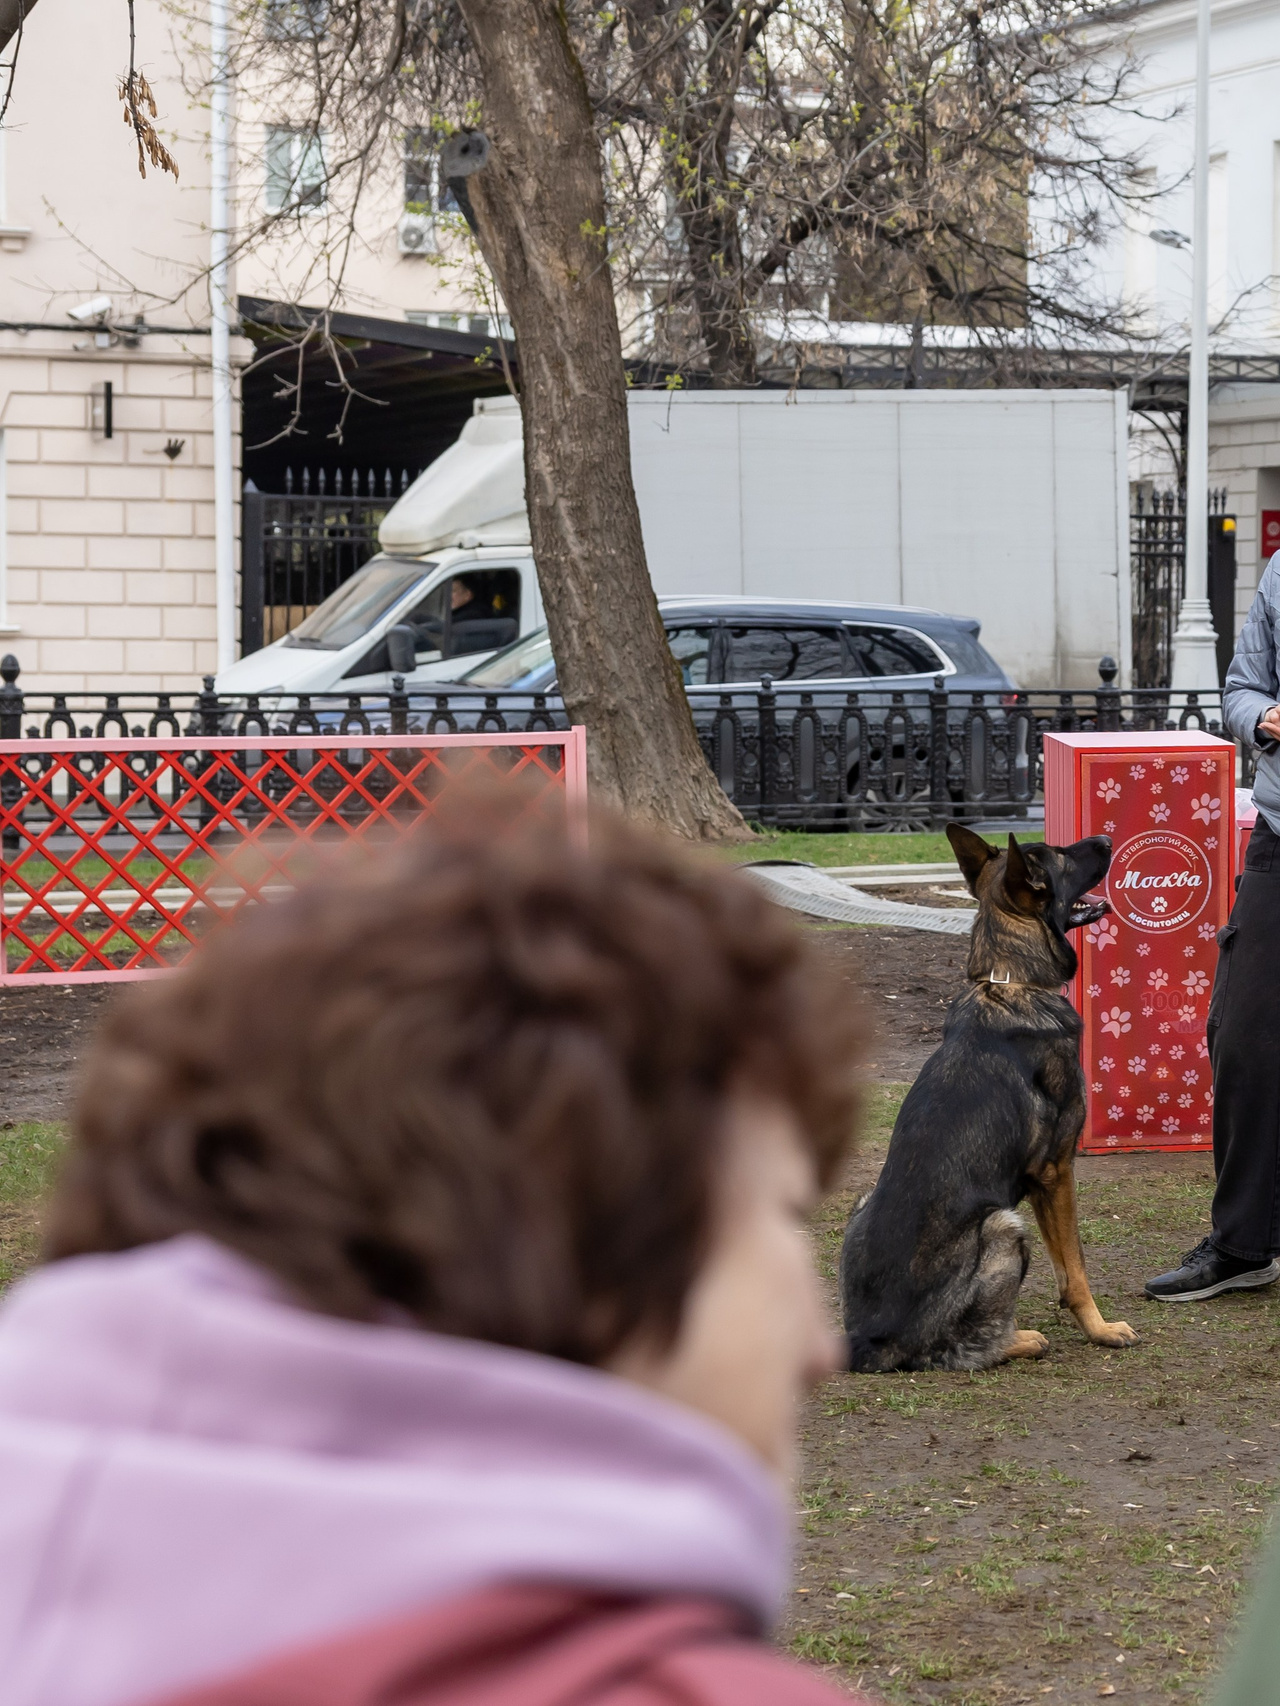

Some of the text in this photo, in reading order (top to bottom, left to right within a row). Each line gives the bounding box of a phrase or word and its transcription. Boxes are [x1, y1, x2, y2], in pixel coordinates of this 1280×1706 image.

[1119, 836, 1199, 863] ЧЕТВЕРОНОГИЙ ДРУГ
[1115, 871, 1203, 889] Москва
[1128, 911, 1191, 928] МОСПИТОМЕЦ
